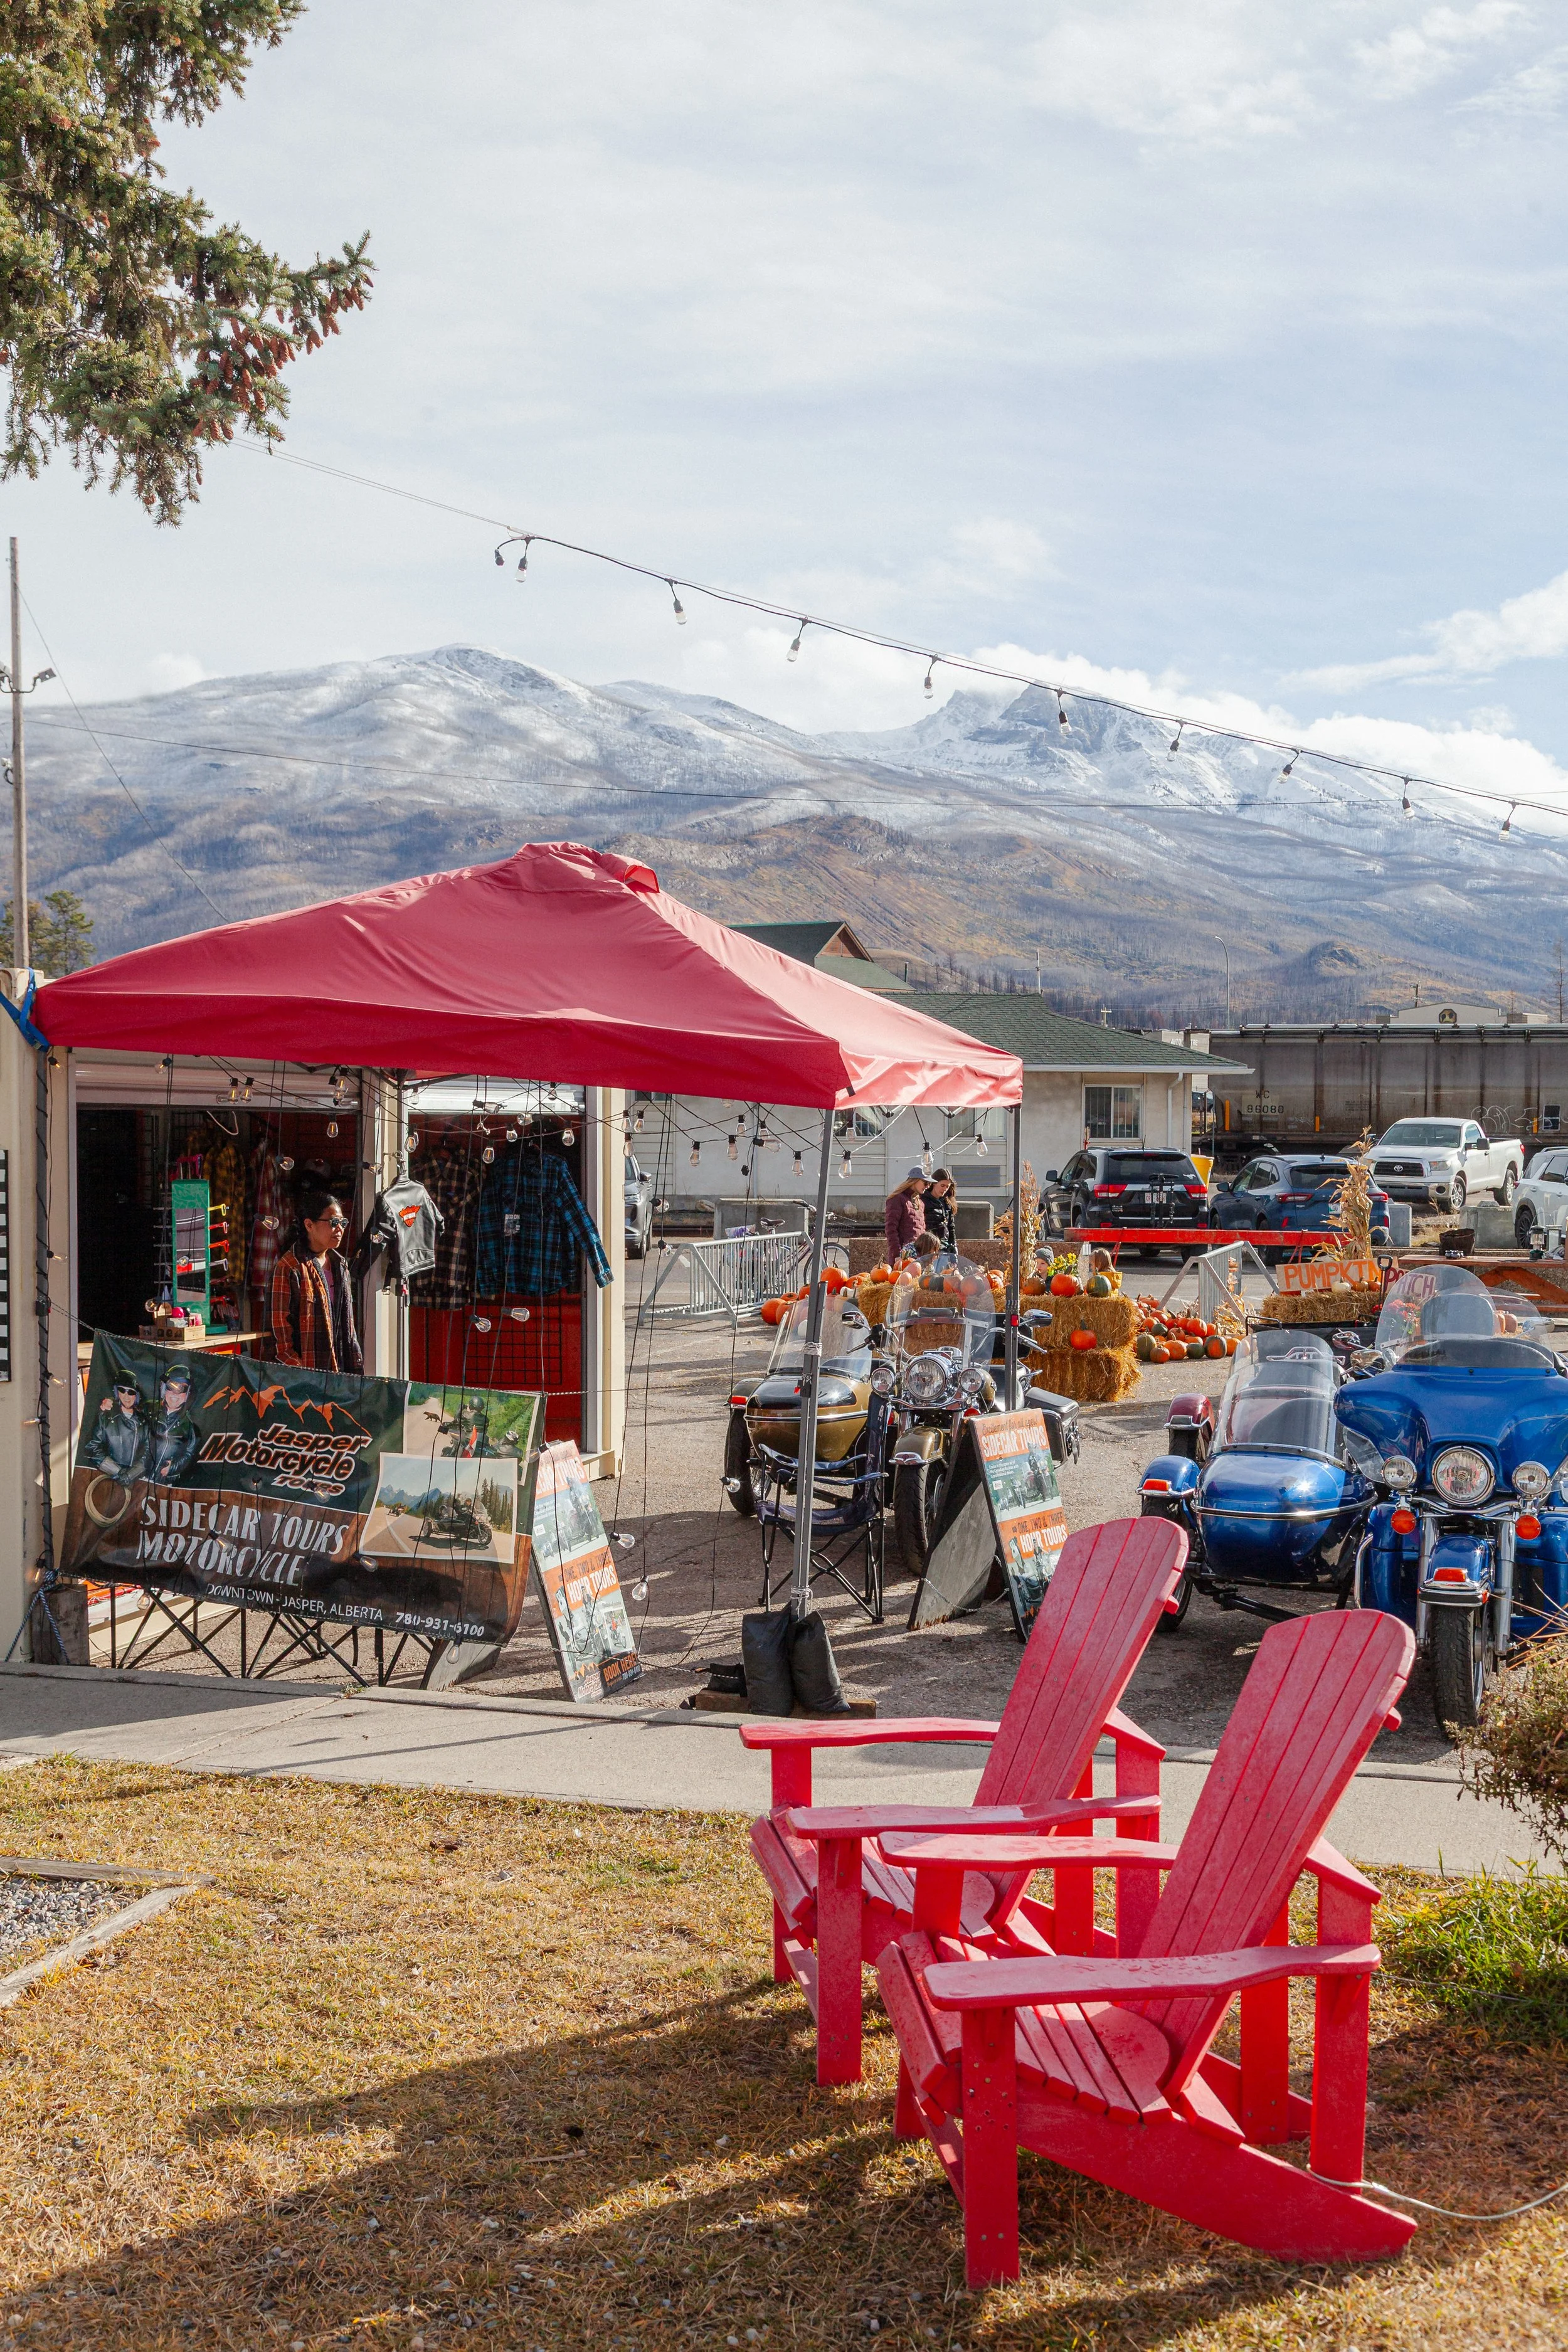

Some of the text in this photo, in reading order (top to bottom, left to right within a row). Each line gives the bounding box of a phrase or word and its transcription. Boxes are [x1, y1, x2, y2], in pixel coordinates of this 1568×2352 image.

[1247, 1104, 1285, 1114] 86080
[1284, 1259, 1435, 1298] PUMPKIN PATCH
[258, 1423, 373, 1454] Jasper
[982, 1425, 1047, 1458] SIDECAR TOURS
[197, 1433, 355, 1481] Motorcycle
[140, 1496, 349, 1555] SIDECAR TOURS
[1030, 1517, 1042, 1530] TWO
[1047, 1512, 1064, 1526] THREE
[1019, 1523, 1068, 1554] HOUR TOURS
[135, 1530, 306, 1587] MOTORCYCLE
[566, 1564, 617, 1604] HOUR TOURS
[206, 1583, 274, 1604] DOWNTOWN
[282, 1596, 327, 1614] JASPER,
[329, 1602, 383, 1621] ALBERTA
[395, 1612, 485, 1637] 780-931-6100
[603, 1661, 621, 1682] BOOK
